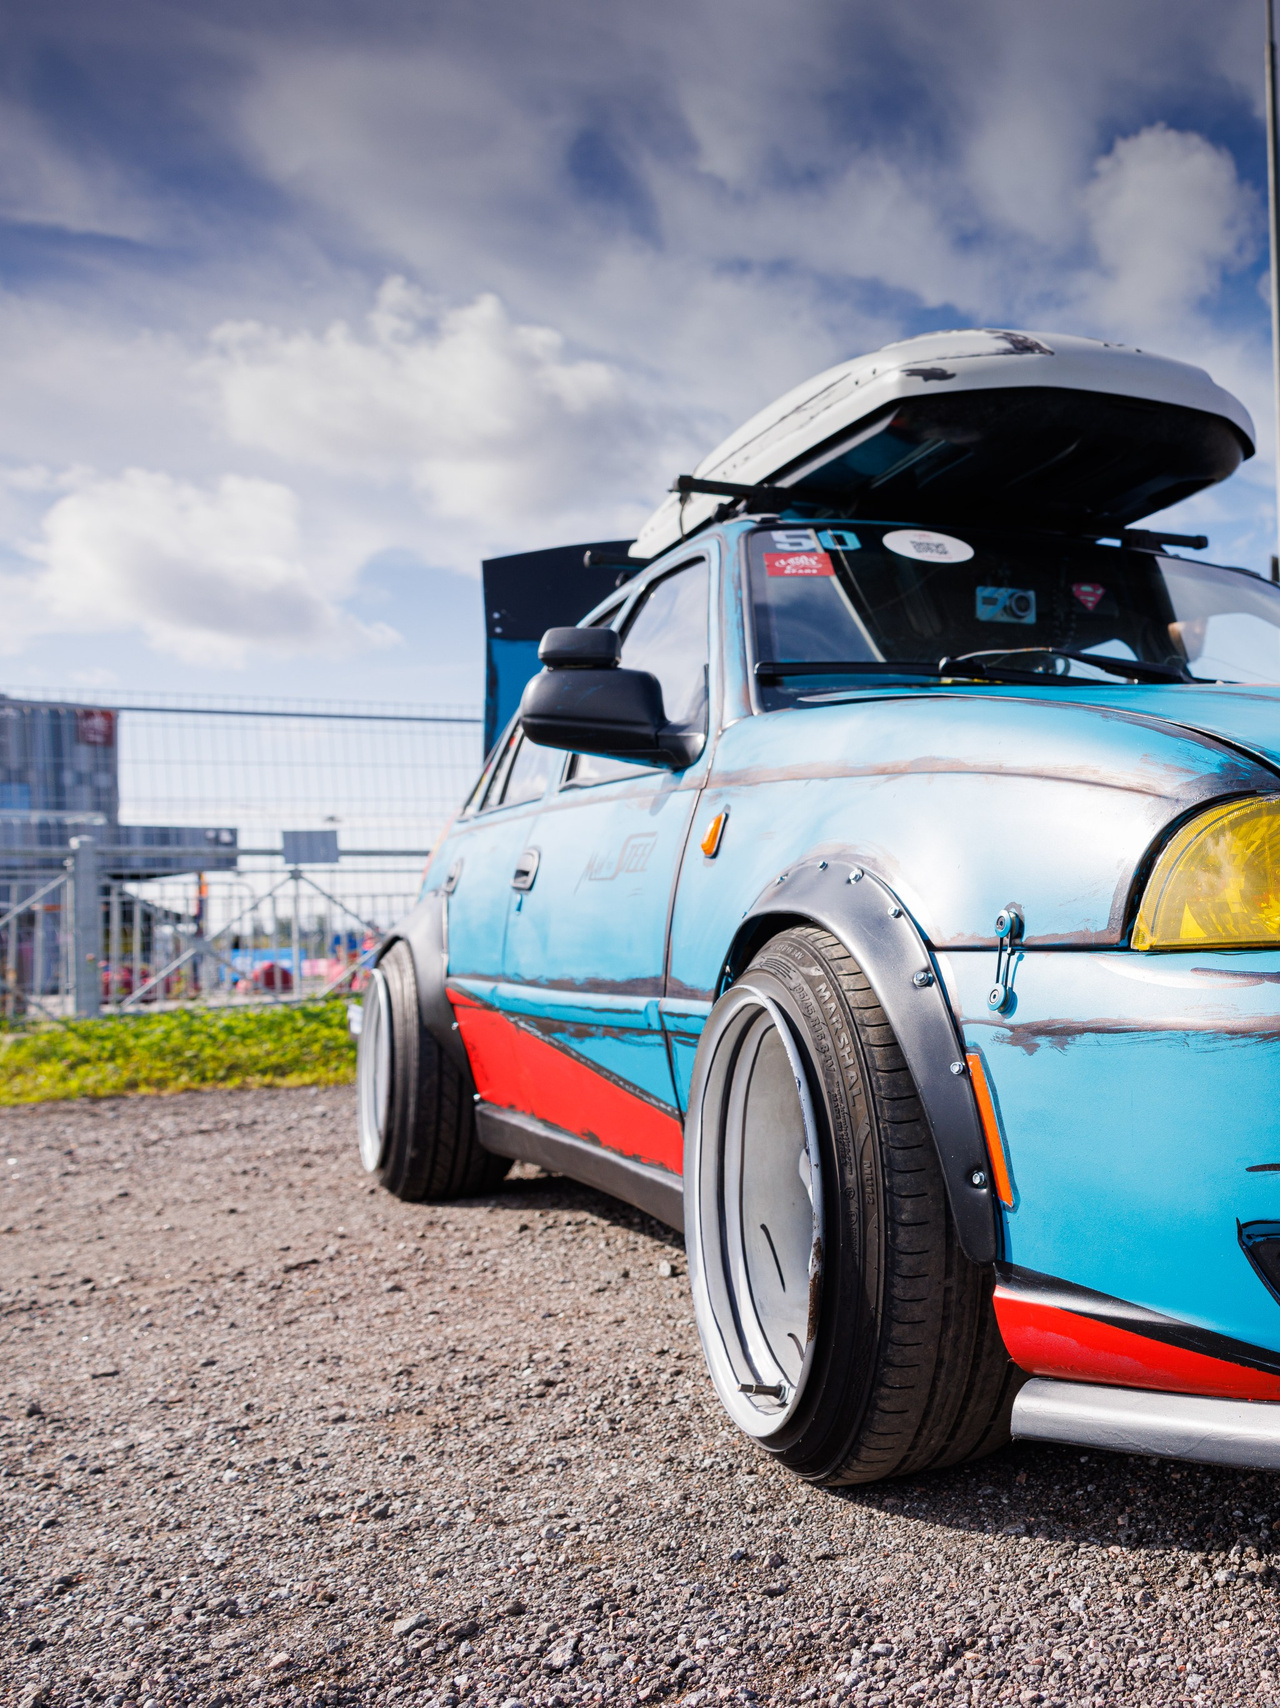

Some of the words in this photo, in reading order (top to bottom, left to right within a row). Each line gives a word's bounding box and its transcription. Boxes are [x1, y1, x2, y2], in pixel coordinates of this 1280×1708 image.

[771, 529, 862, 551] 50
[794, 984, 816, 1015] 195/45
[816, 982, 862, 1108] MARSHAL
[863, 1160, 875, 1205] MU12
